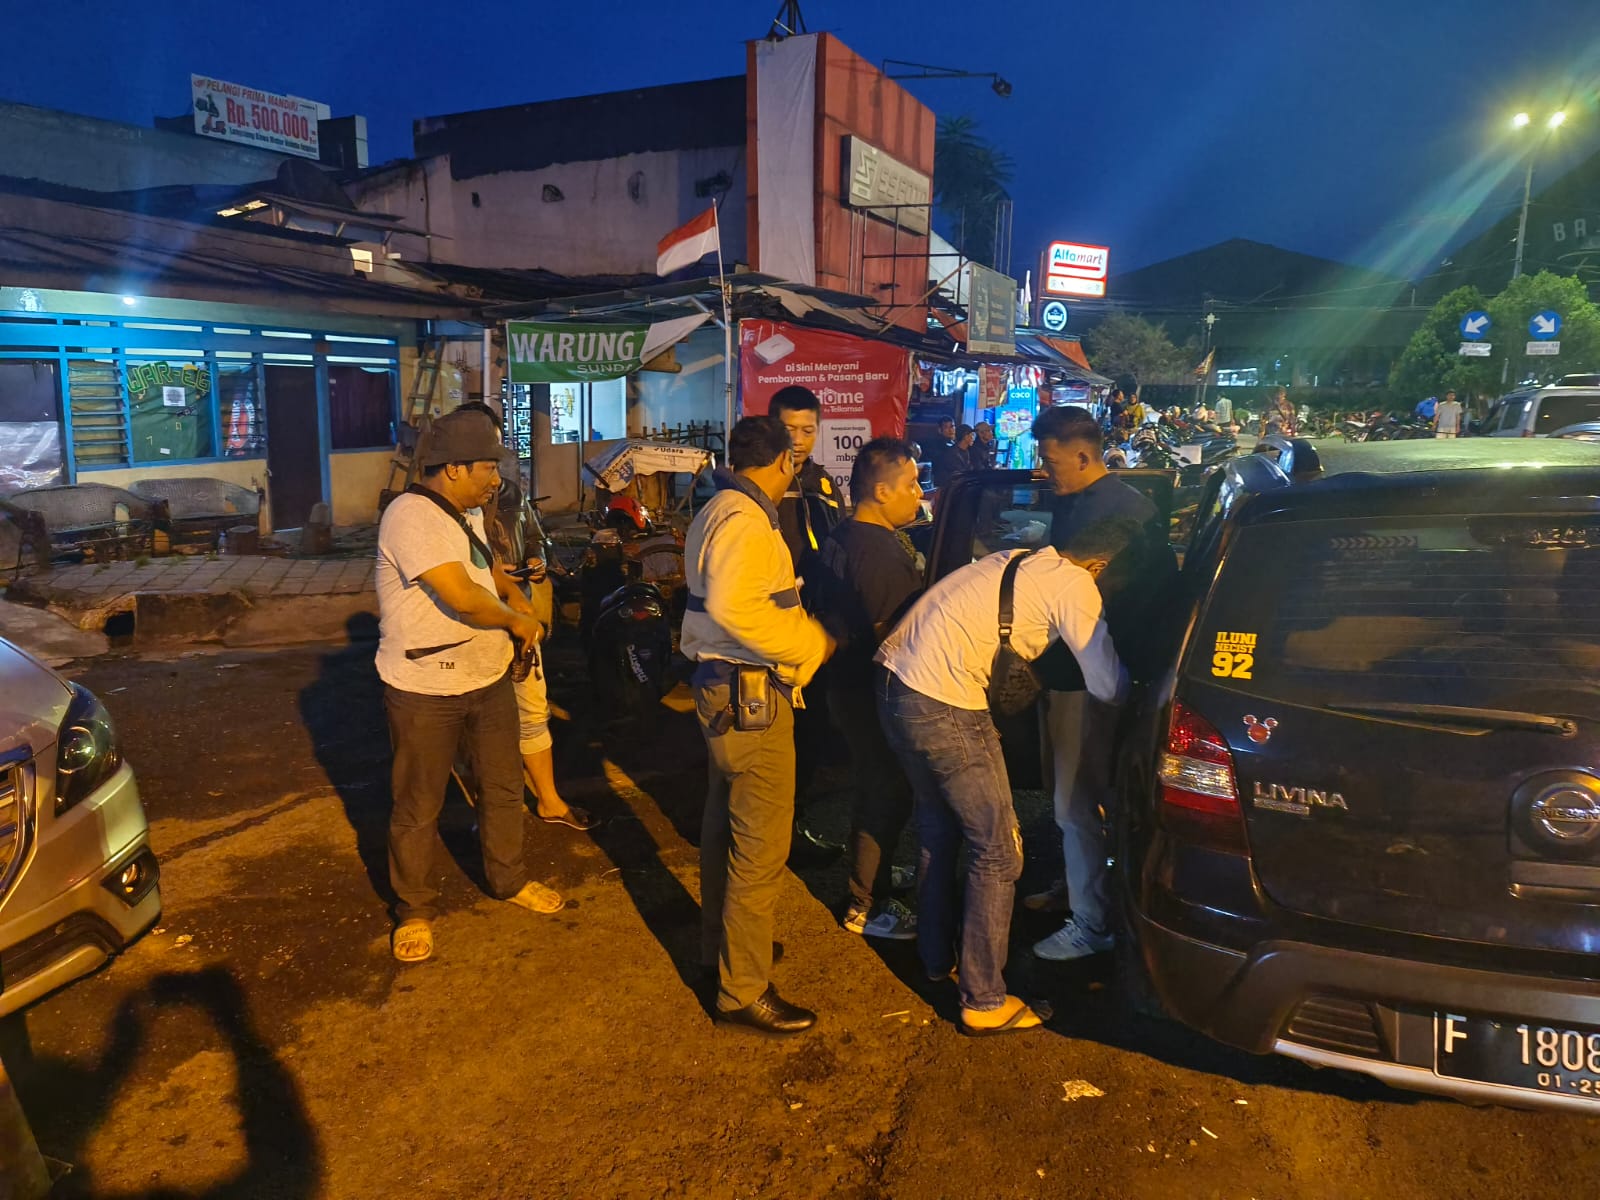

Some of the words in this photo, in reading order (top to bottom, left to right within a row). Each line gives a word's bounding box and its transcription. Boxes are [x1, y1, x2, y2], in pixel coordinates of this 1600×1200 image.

[206, 79, 241, 98] PELANGI
[241, 88, 266, 103] PRIMA
[1054, 248, 1103, 265] Alfamart
[511, 331, 635, 363] WARUNG
[785, 362, 795, 372] Di
[796, 362, 814, 372] Sini
[815, 361, 860, 373] Melayani
[758, 374, 817, 384] Pembayaran
[818, 374, 826, 382] &
[827, 373, 864, 384] Pasang
[864, 372, 889, 380] Baru
[833, 435, 863, 450] 100
[835, 453, 857, 463] mbp
[1216, 631, 1257, 645] ILUNI
[438, 661, 456, 670] TM
[1211, 652, 1254, 679] 92
[1253, 781, 1349, 810] LIVINA
[1444, 1013, 1468, 1053] F
[1516, 1023, 1600, 1075] 1808
